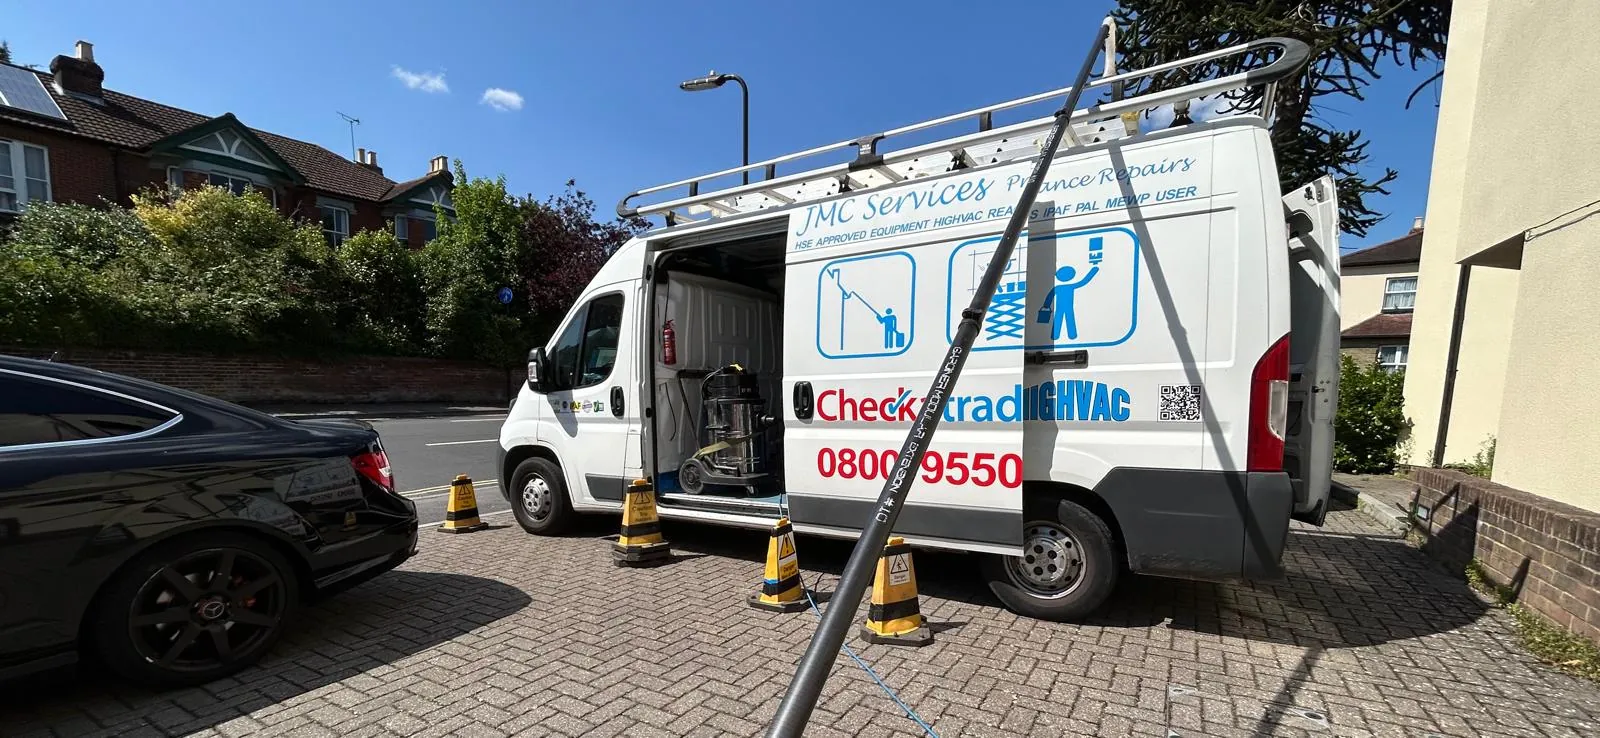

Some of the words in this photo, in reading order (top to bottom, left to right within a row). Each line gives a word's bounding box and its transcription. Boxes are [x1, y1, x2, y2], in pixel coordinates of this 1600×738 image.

[1099, 157, 1197, 186] Repairs
[795, 239, 813, 250] HSE
[816, 231, 866, 247] APPROVED
[870, 220, 929, 237] EQUIPMENT
[933, 211, 983, 228] HIGHVAC
[1043, 204, 1072, 218] IPAF
[1075, 201, 1100, 213] PAL
[1105, 192, 1151, 208] MEWP
[1155, 186, 1198, 202] USER
[796, 198, 856, 236] JMC
[862, 178, 995, 220] Services
